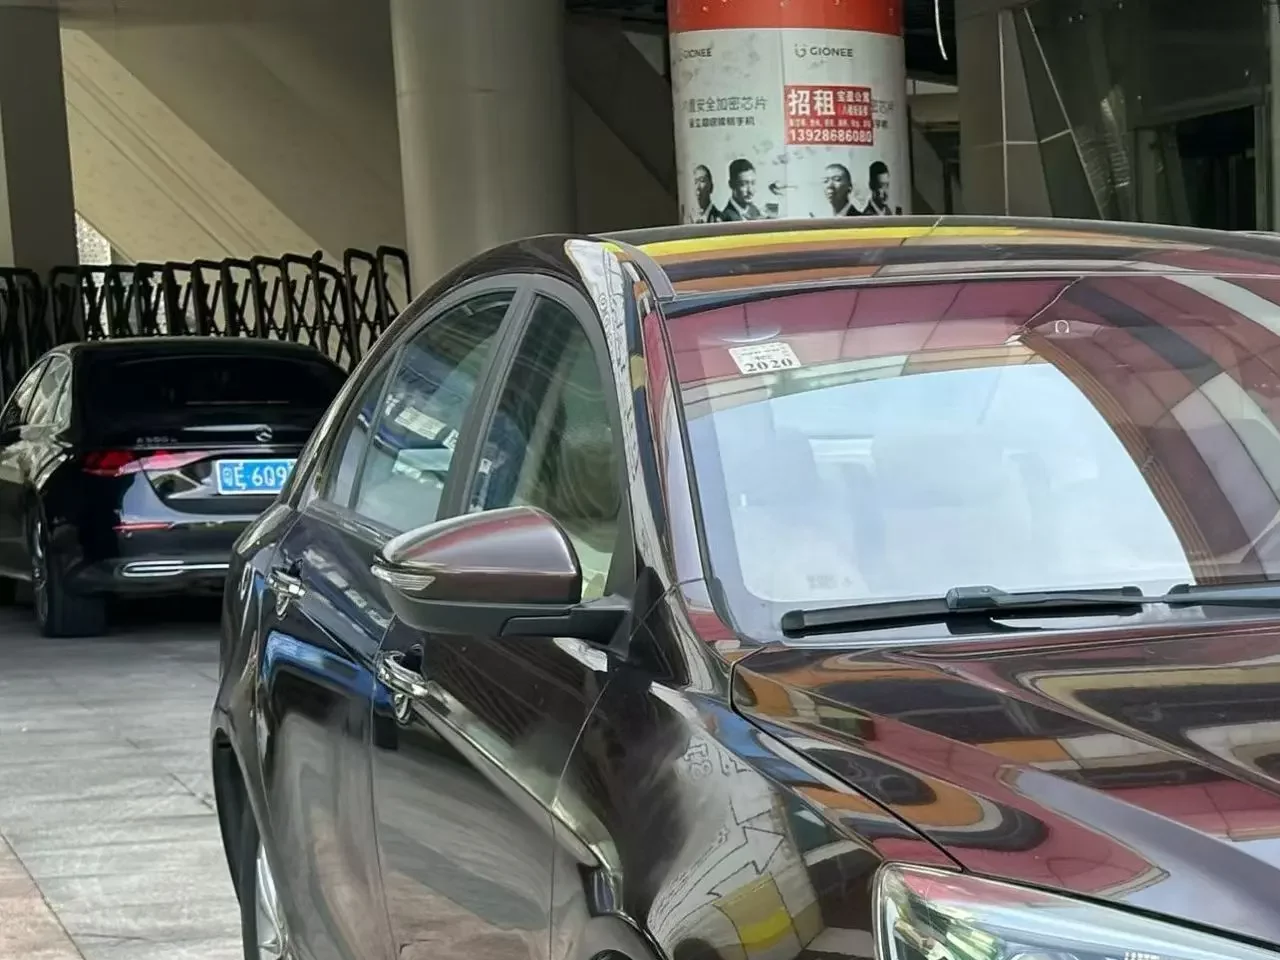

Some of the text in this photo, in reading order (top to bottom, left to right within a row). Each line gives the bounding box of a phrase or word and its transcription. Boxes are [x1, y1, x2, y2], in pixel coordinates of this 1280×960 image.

[810, 46, 853, 57] GIONEE
[787, 88, 835, 116] 招租
[743, 357, 793, 372] 2020
